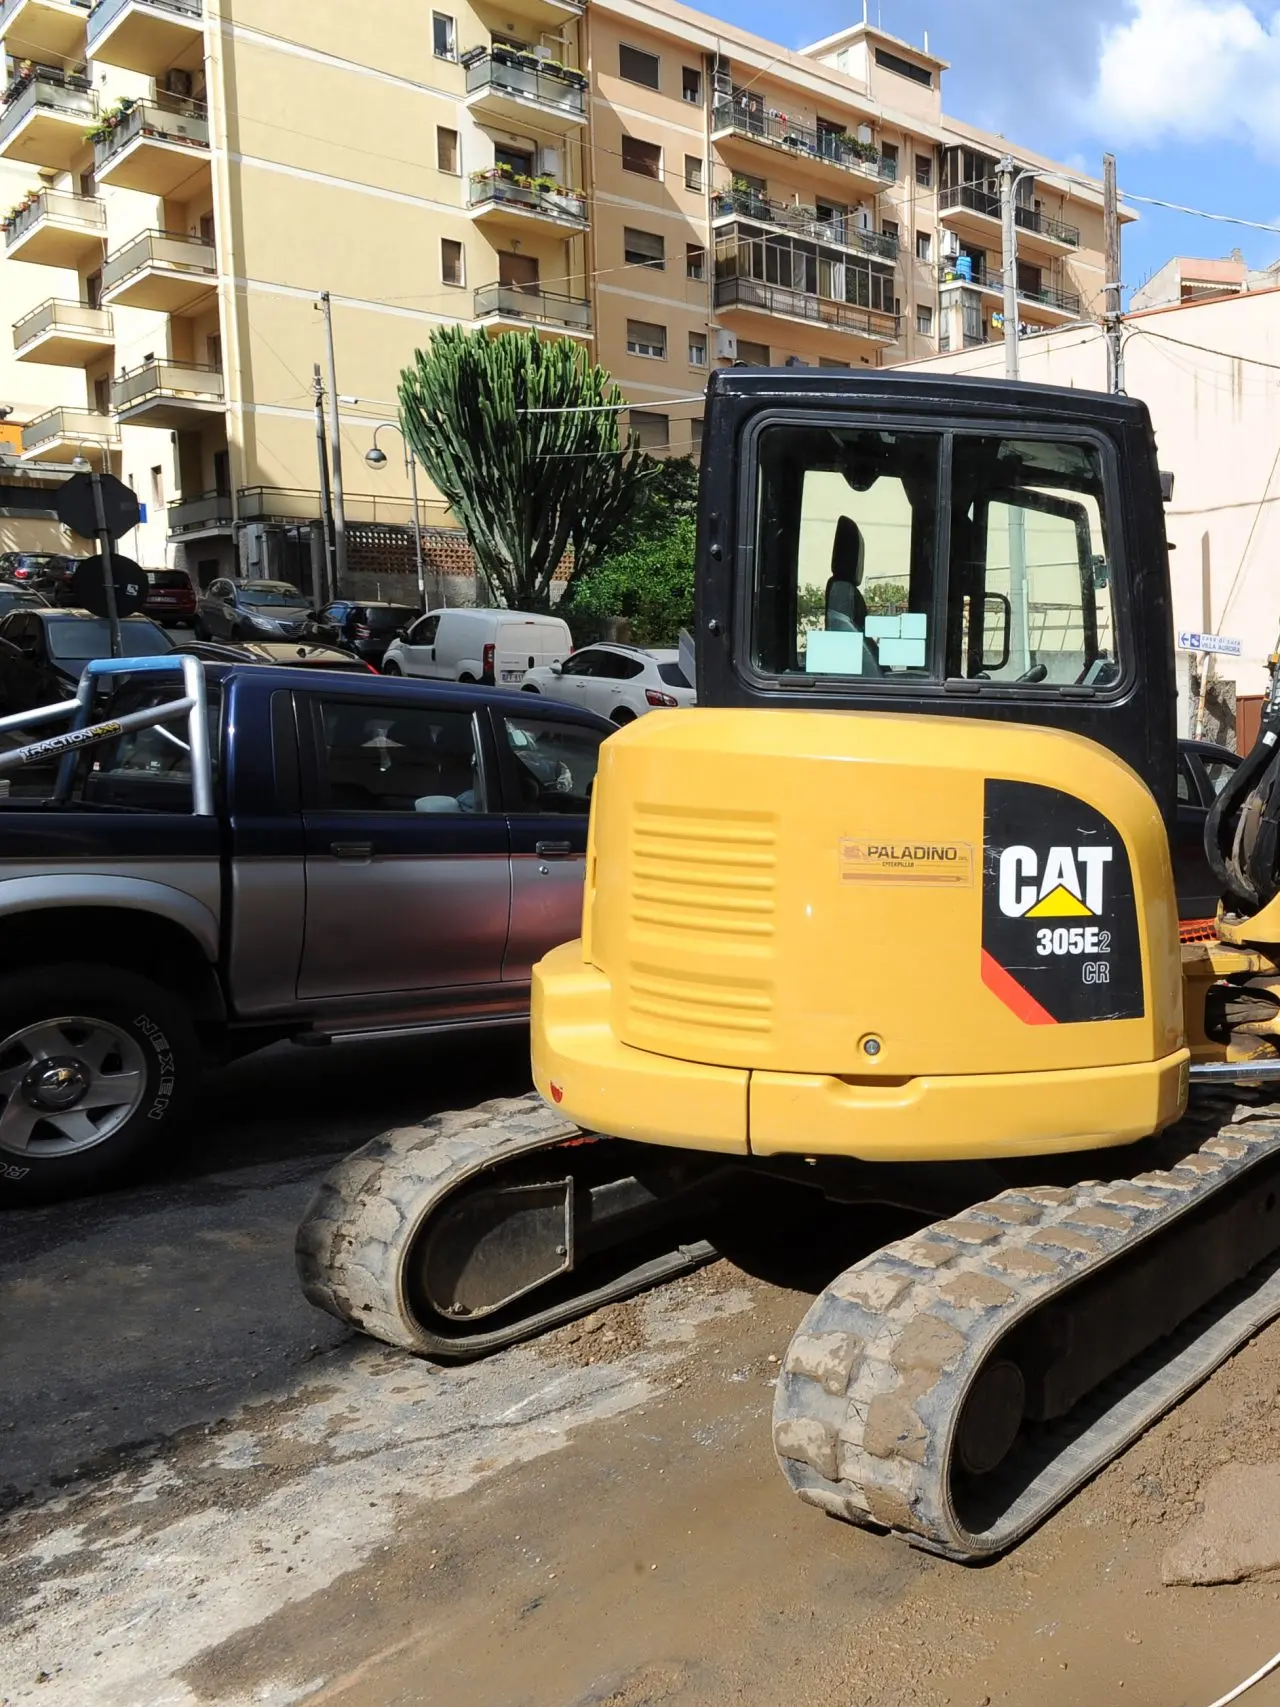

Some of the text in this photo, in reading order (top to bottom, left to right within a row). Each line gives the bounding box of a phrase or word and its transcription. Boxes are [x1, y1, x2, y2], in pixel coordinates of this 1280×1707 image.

[867, 846, 958, 861] PALADINO
[999, 845, 1113, 918] CAT
[1082, 961, 1110, 985] CR
[133, 1014, 175, 1120] NEXEN
